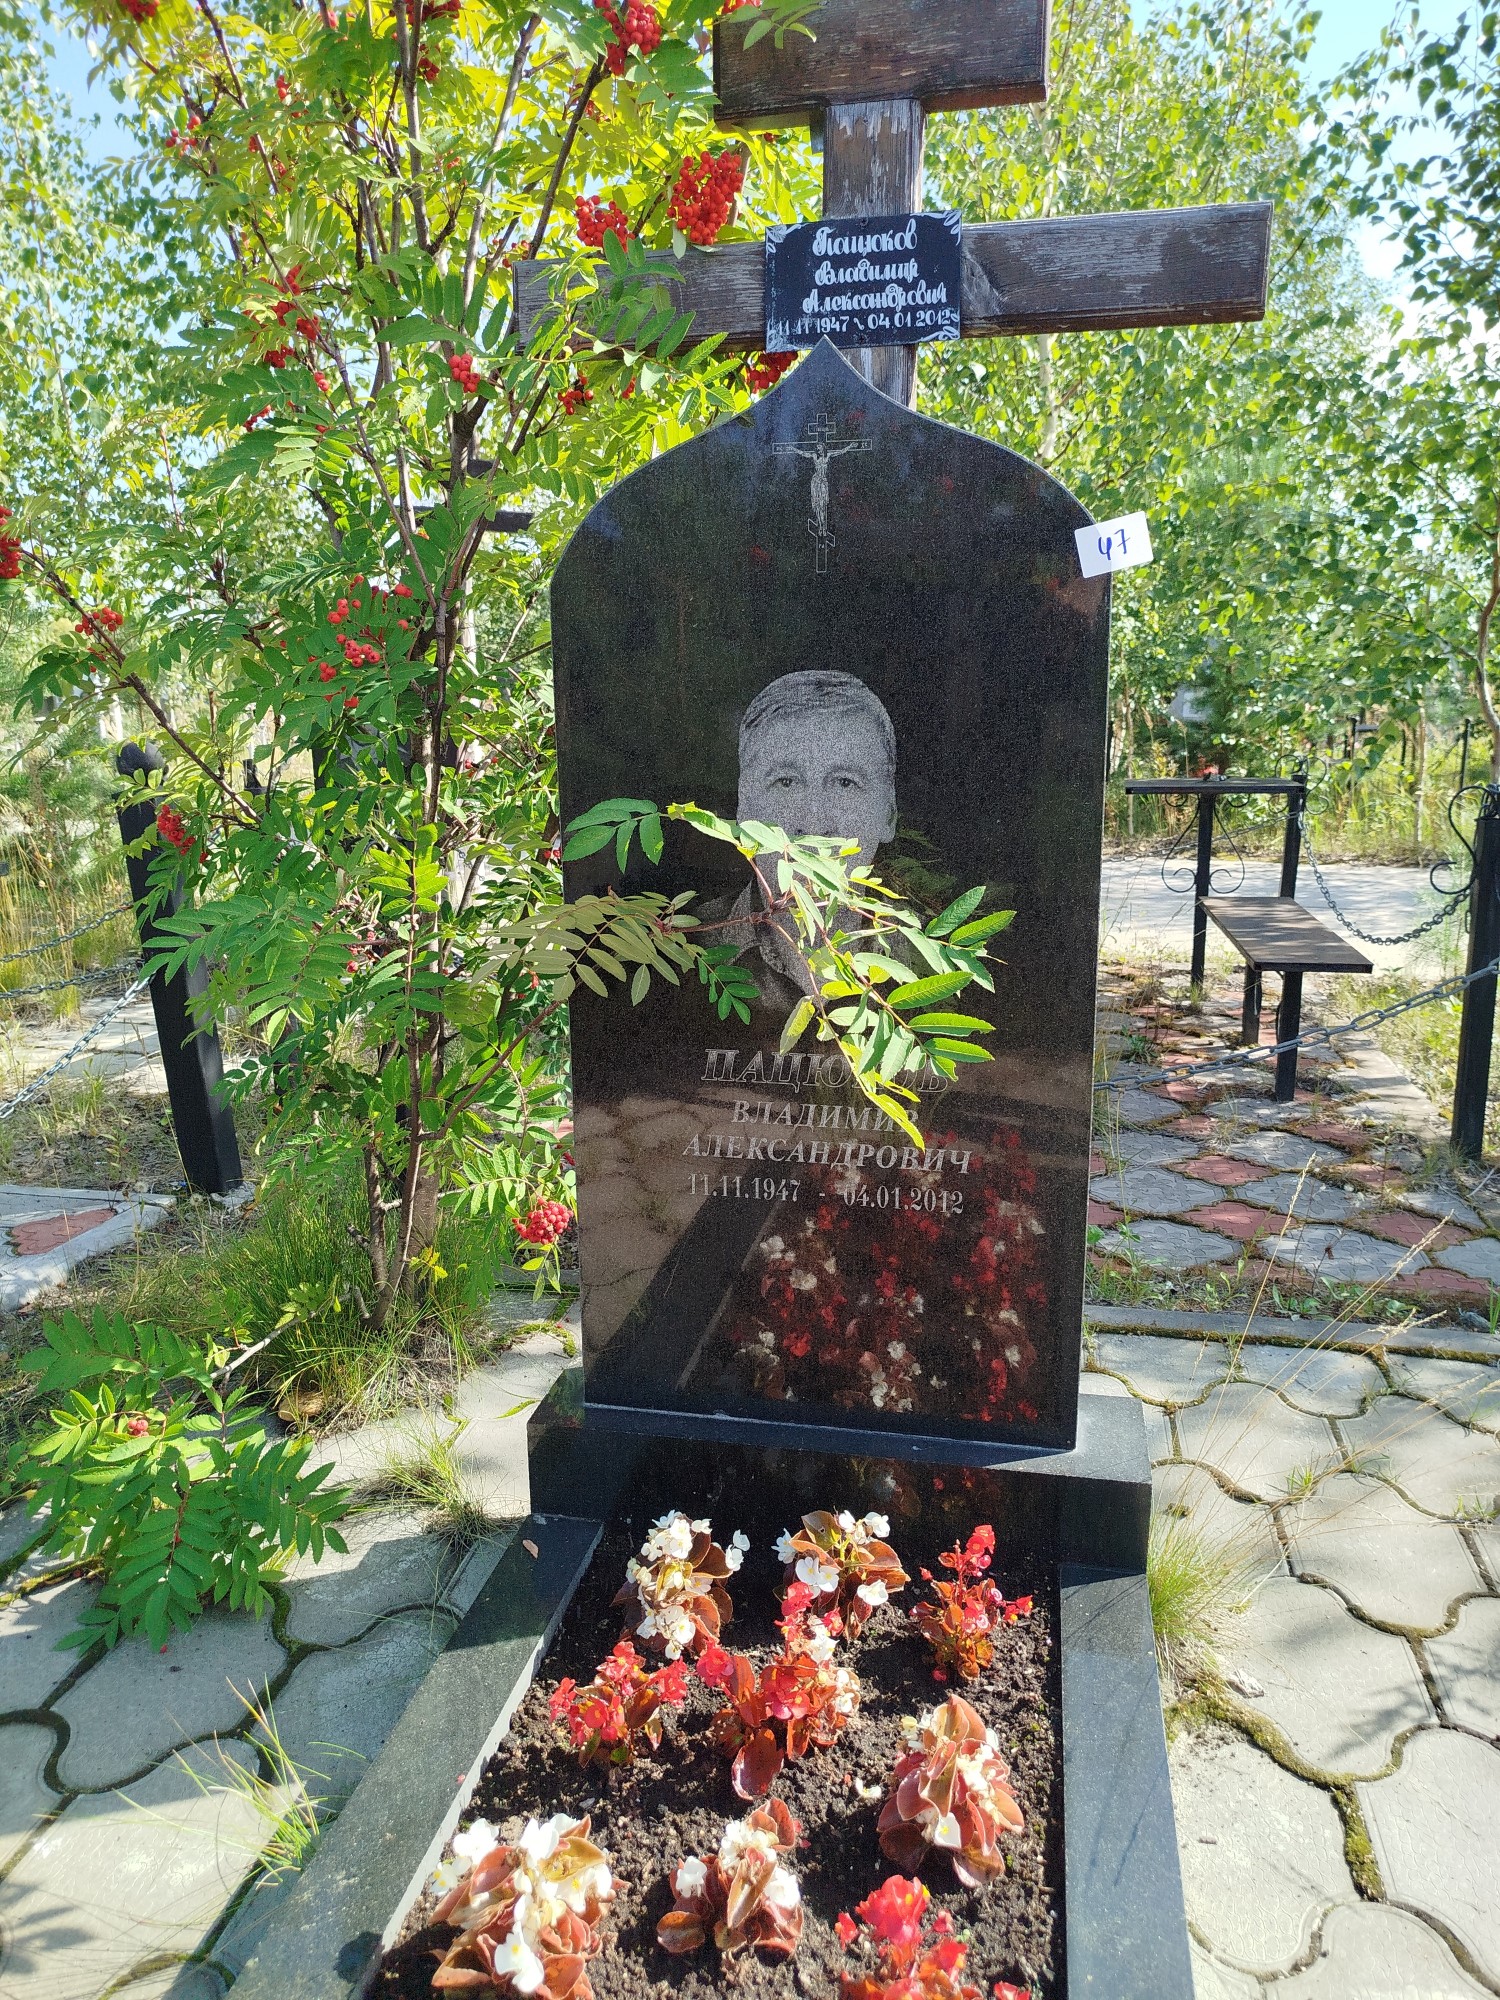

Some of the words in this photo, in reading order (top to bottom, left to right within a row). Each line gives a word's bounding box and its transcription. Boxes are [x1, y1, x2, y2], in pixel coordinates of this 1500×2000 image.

[814, 258, 919, 286] Владимир
[802, 280, 947, 314] Александрович
[1097, 528, 1131, 561] 47
[682, 1134, 973, 1175] АЛЕКСАНДРОВИЧ
[687, 1172, 801, 1203] 11.11.1947
[843, 1184, 964, 1215] 04.01.2012
